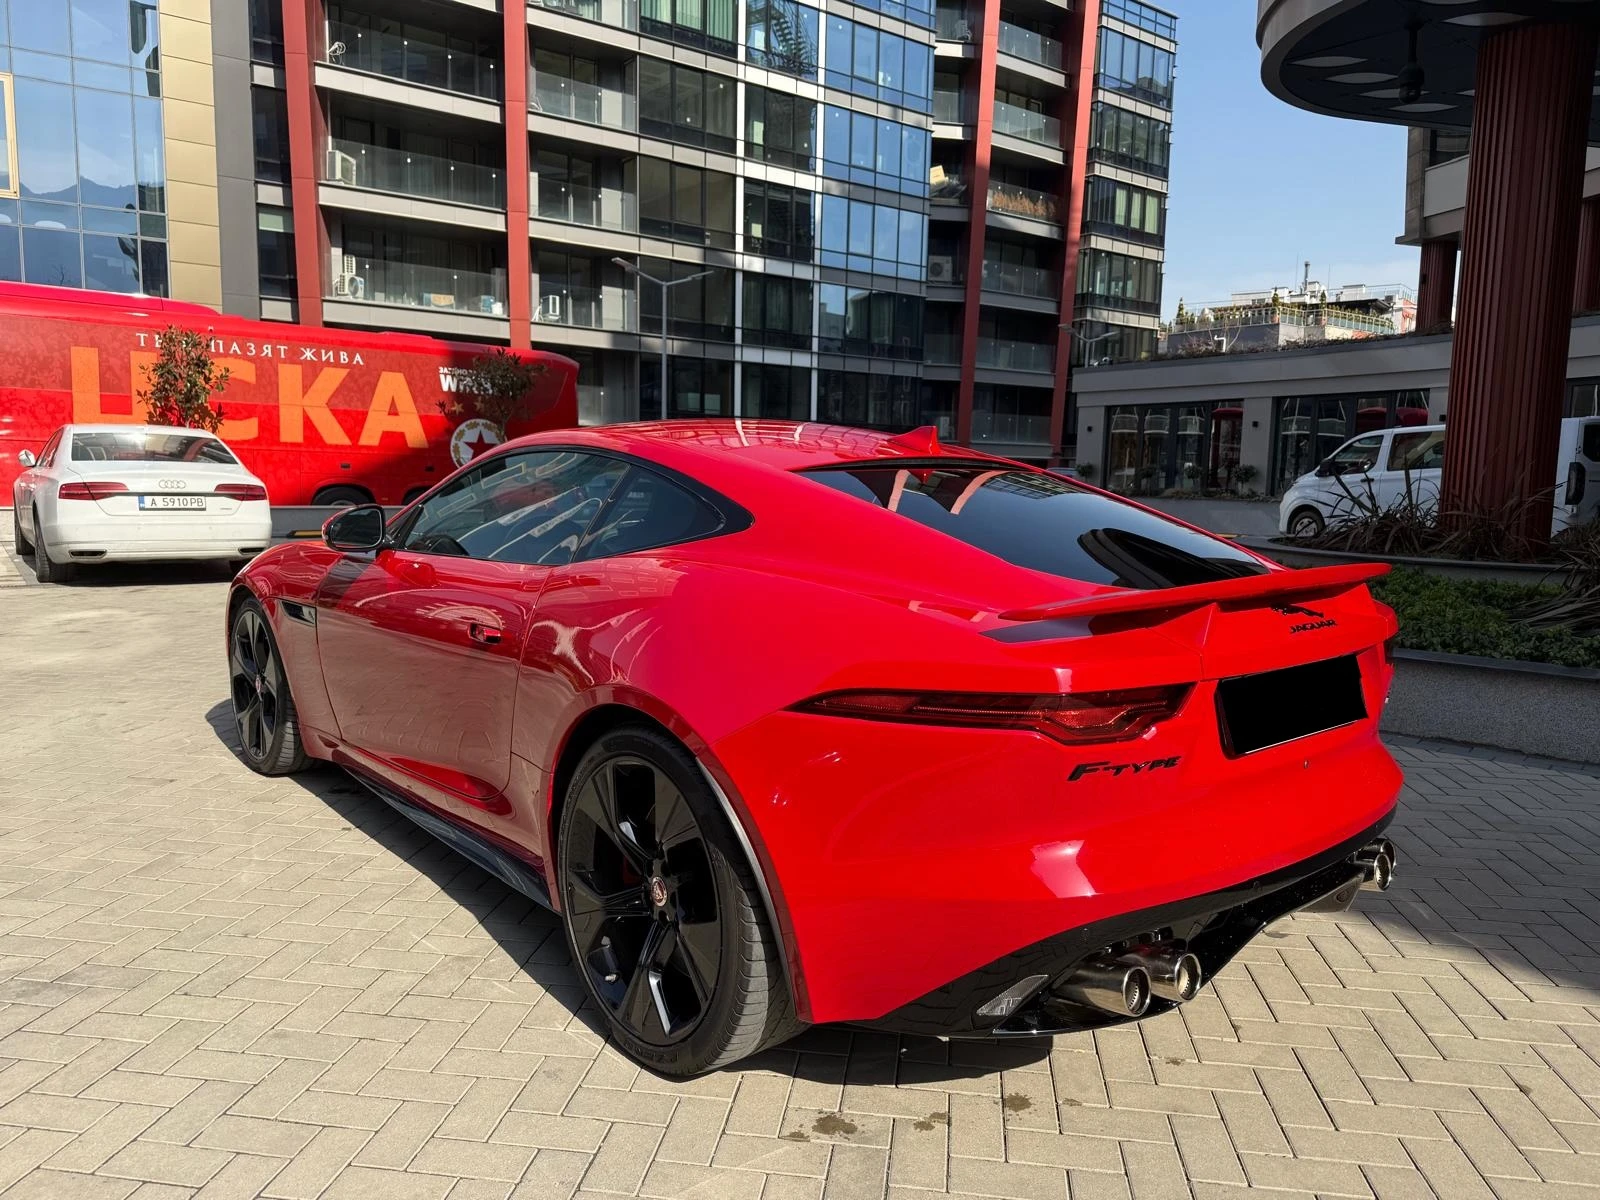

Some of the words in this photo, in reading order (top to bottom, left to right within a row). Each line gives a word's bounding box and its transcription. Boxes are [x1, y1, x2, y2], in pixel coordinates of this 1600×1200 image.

[211, 339, 289, 358] ПАЗЯТ
[300, 347, 365, 366] ЖИВА
[1289, 618, 1337, 634] JAGUAR
[1066, 755, 1182, 782] F-TYPE
